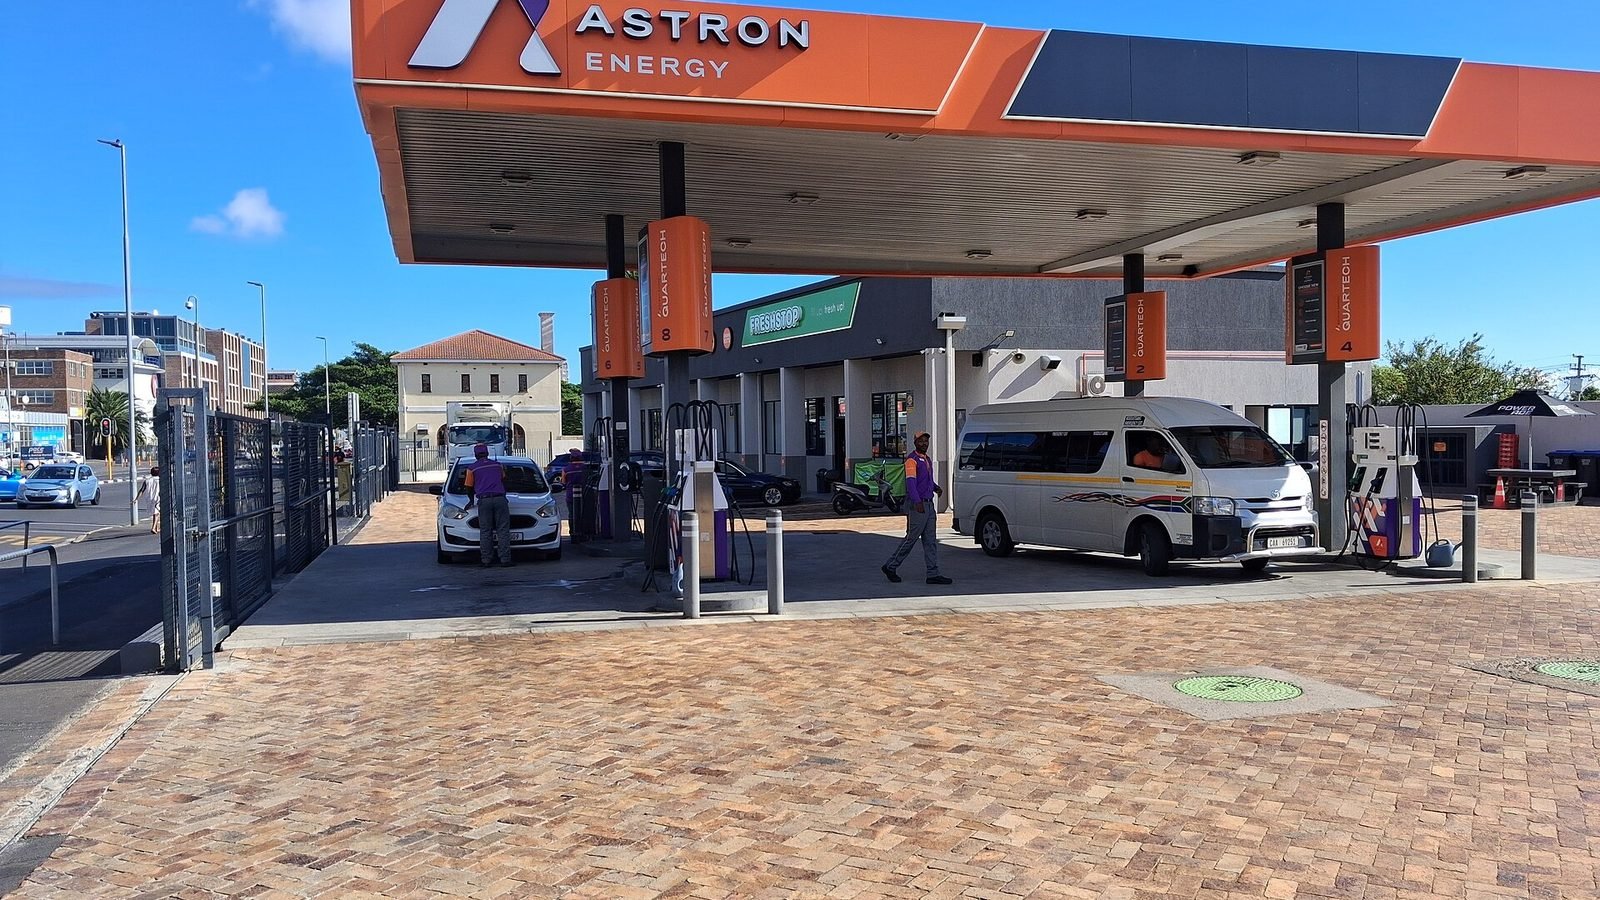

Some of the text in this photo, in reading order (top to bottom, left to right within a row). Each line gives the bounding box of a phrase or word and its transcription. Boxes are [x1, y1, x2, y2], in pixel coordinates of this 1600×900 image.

[574, 4, 811, 50] ASTRON
[585, 52, 729, 79] ENERGY
[658, 229, 669, 318] QUARTECH
[1335, 256, 1351, 332] QUARTECH
[602, 288, 610, 353] QUARTECH
[662, 328, 671, 341] 8
[750, 305, 802, 336] FRESHSTOP
[1133, 299, 1144, 358] QUARTECH
[704, 330, 709, 342] 7
[1340, 341, 1353, 353] 4
[605, 360, 612, 370] 6
[1136, 365, 1145, 374] 2
